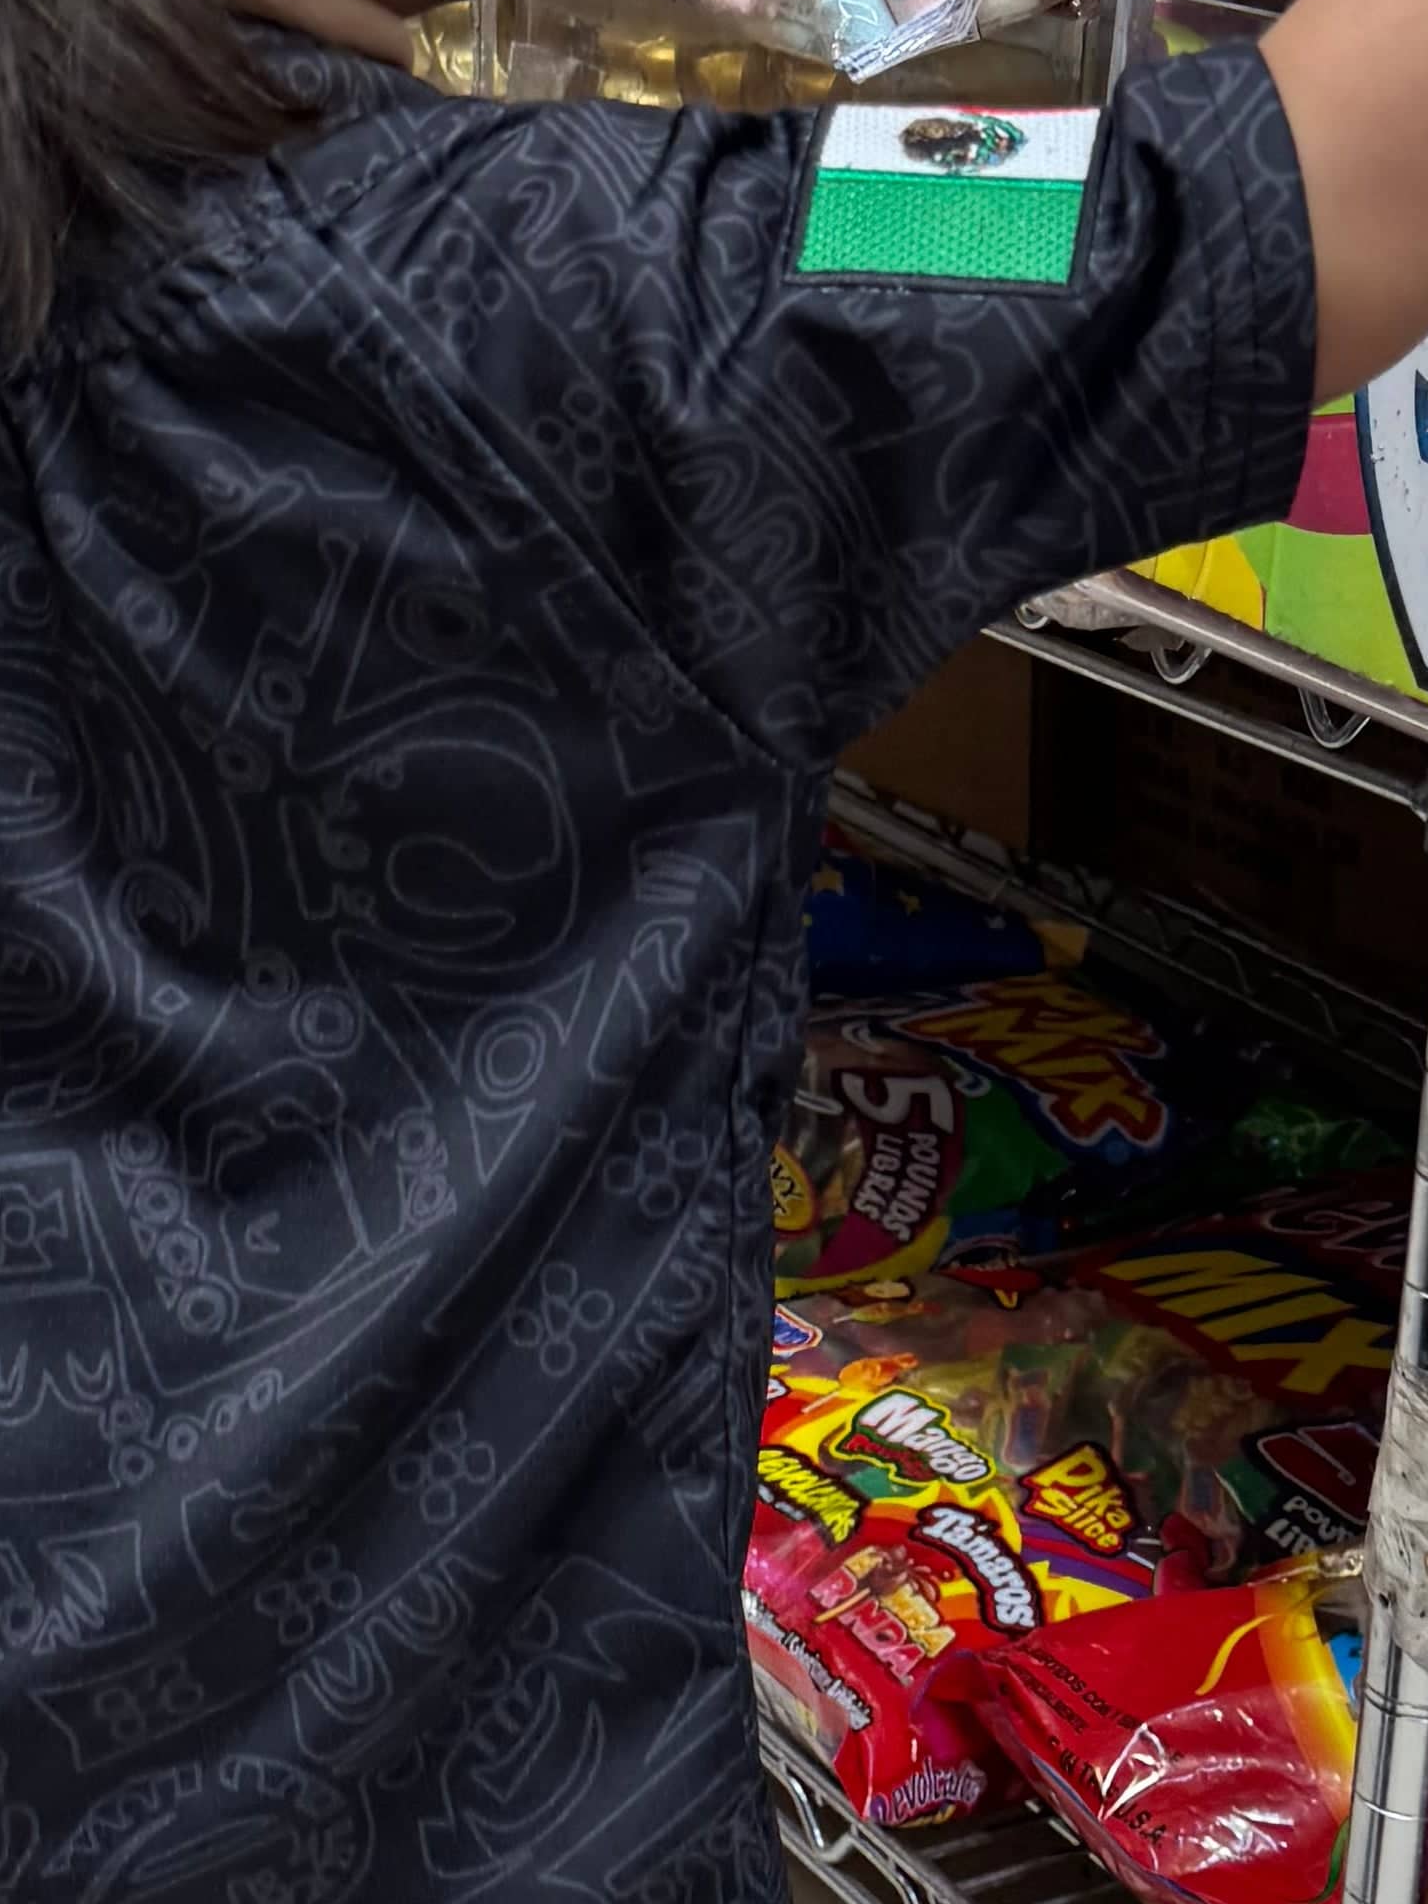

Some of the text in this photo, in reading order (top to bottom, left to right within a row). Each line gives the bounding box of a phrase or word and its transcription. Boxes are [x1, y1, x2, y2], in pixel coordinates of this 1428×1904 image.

[842, 1070, 958, 1151] 5
[851, 1132, 904, 1228] LIBRAS
[898, 1130, 940, 1244] POUNDS
[1099, 1249, 1397, 1396] MIX
[861, 1395, 989, 1484] Mango
